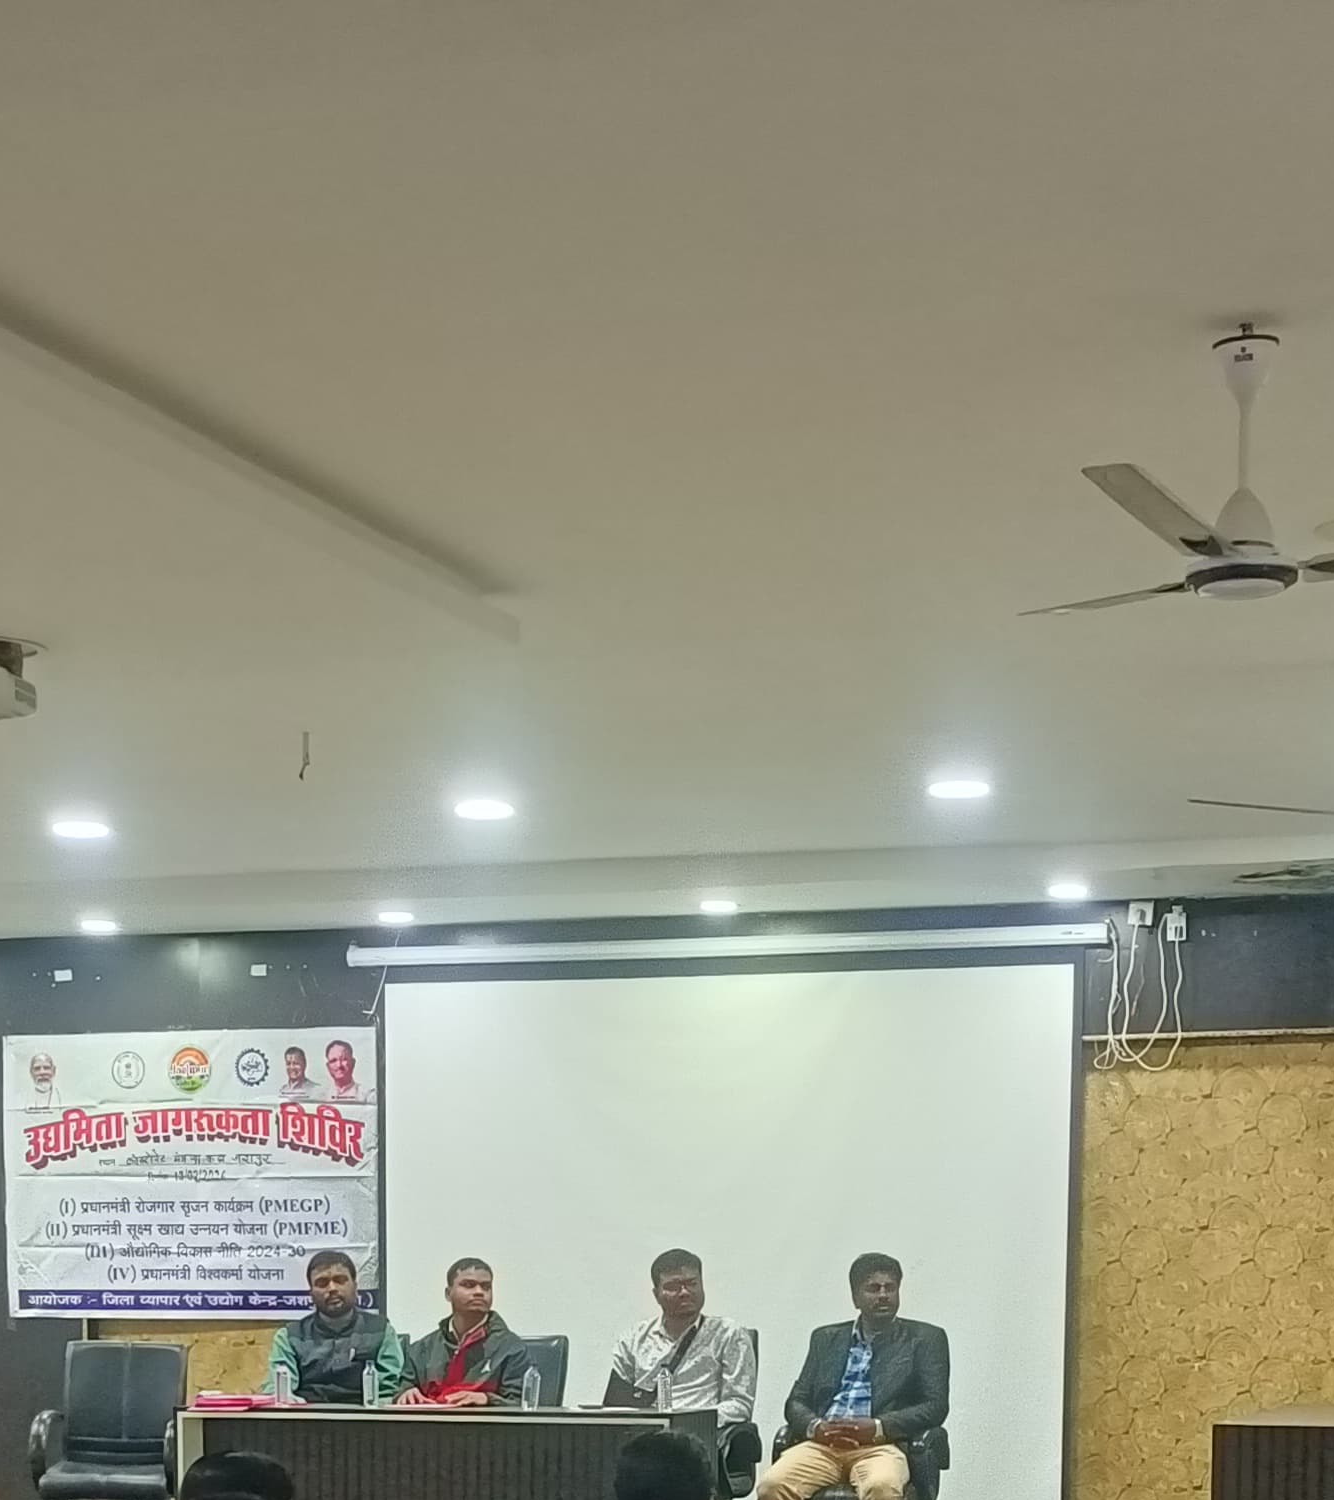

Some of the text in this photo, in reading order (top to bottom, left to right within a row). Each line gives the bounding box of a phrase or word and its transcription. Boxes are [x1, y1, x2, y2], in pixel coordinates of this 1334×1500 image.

[23, 1108, 126, 1168] उद्यमिता
[276, 1102, 365, 1167] शिविर
[80, 1197, 131, 1213] प्रधानमंत्री
[135, 1197, 175, 1213] रोजगार
[180, 1200, 209, 1217] सृजन
[214, 1197, 253, 1213] कार्यक्रम
[259, 1195, 331, 1215] (PMEGP)
[71, 1220, 121, 1236] प्रधानमंत्री
[126, 1223, 152, 1240] सूक्ष्म
[158, 1223, 185, 1236] खाद्य
[190, 1223, 229, 1236] उन्नयन
[233, 1219, 268, 1236] योजना
[273, 1218, 348, 1238] (PMFME)
[119, 1242, 172, 1258] औद्योगिक
[177, 1242, 212, 1258] विकास
[217, 1242, 242, 1258] नीति
[247, 1245, 306, 1258] 2024-30
[141, 1264, 191, 1280] प्रधानमंत्री
[196, 1264, 243, 1280] विश्वकर्मा
[247, 1263, 285, 1280] योजना
[27, 1291, 83, 1306] आयोजक
[101, 1291, 134, 1306] जिला
[139, 1294, 180, 1306] व्यापार
[183, 1291, 203, 1307] एवं
[206, 1291, 243, 1306] उद्योग
